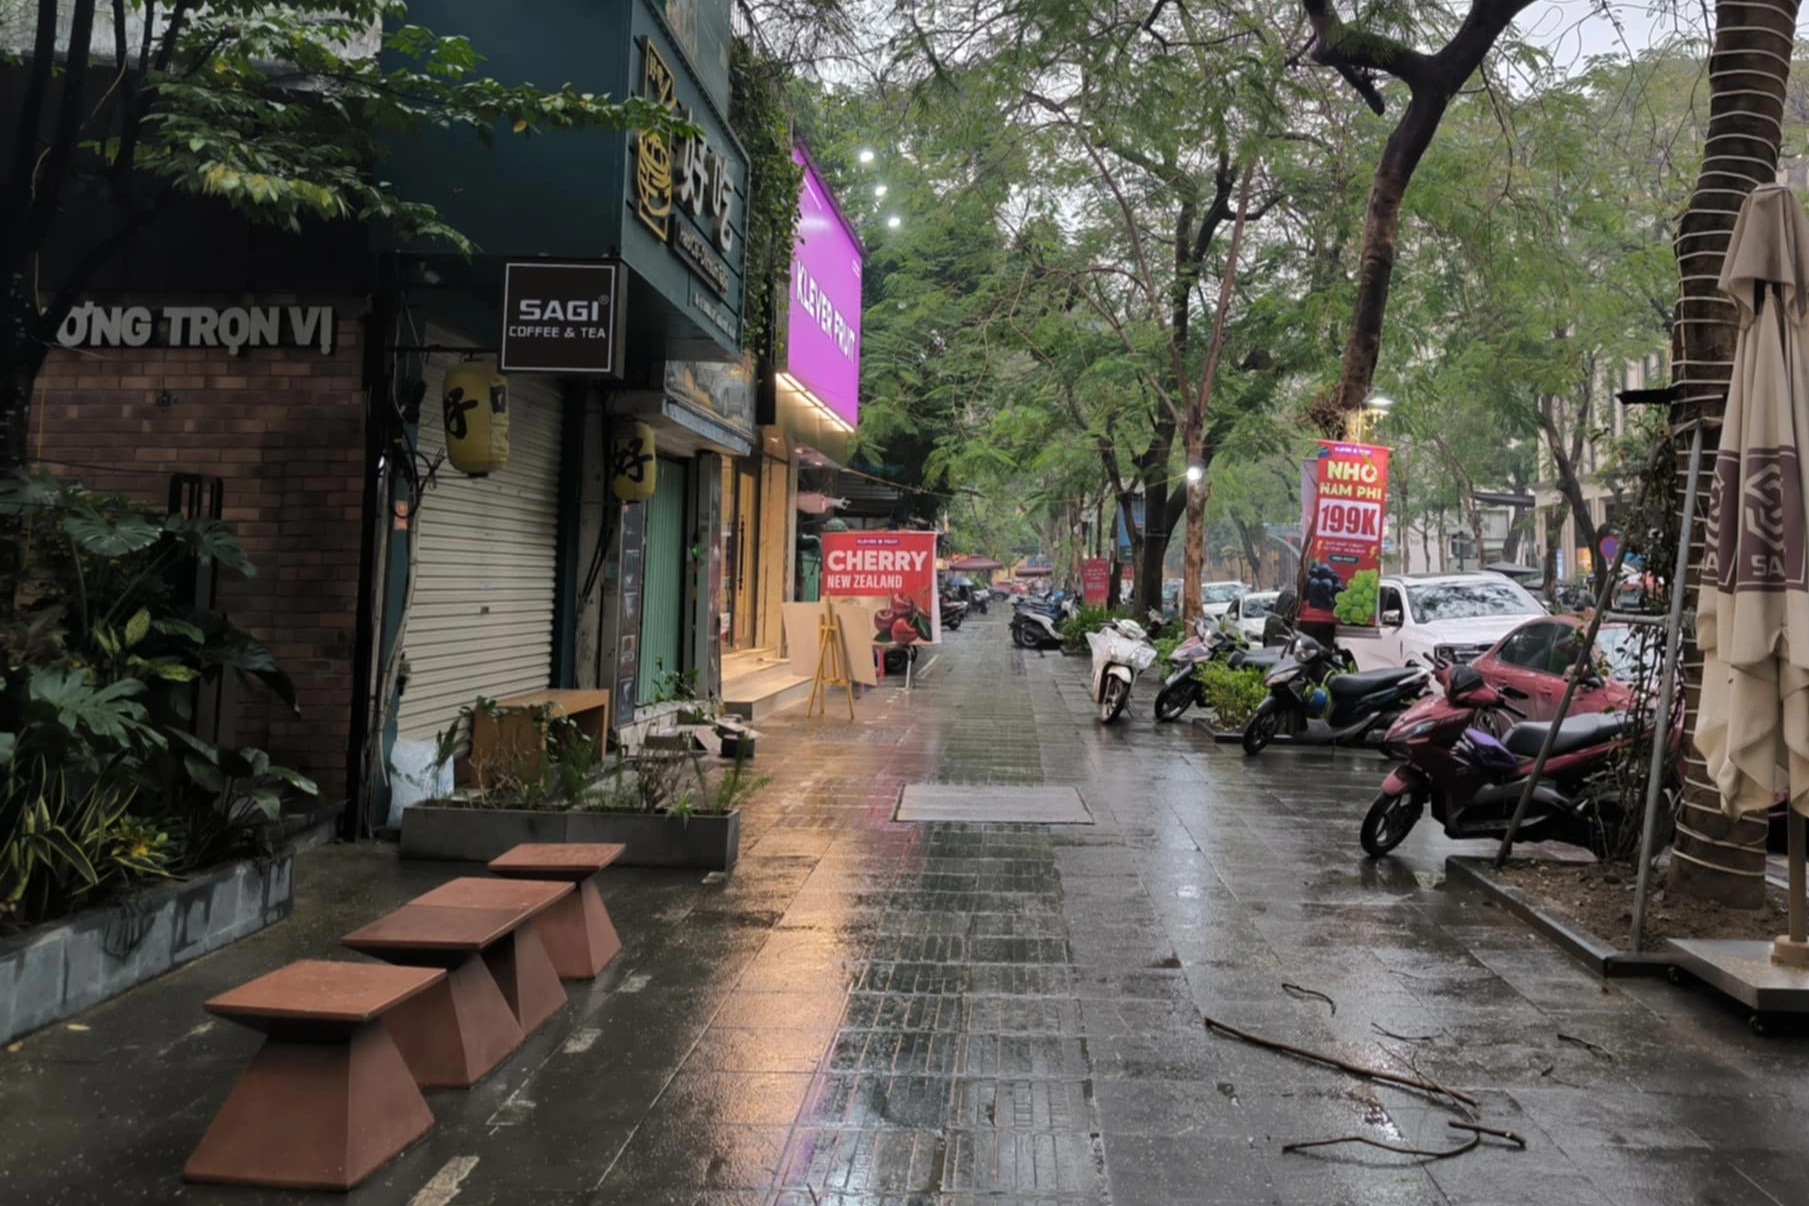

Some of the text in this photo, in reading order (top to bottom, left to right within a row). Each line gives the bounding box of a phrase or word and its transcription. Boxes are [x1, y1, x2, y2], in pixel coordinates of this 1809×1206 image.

[519, 299, 600, 322] SAGI
[796, 260, 856, 364] KLEVER FRUIT
[163, 306, 279, 355] TRỌN
[287, 306, 333, 355] VỊ
[509, 326, 606, 339] COFFEE & TEA
[1327, 460, 1378, 483] NHO
[1319, 482, 1382, 500] NAM PHI
[1321, 504, 1378, 537] 199K
[827, 550, 927, 572] CHERRY
[827, 574, 903, 589] NEW ZEALAND
